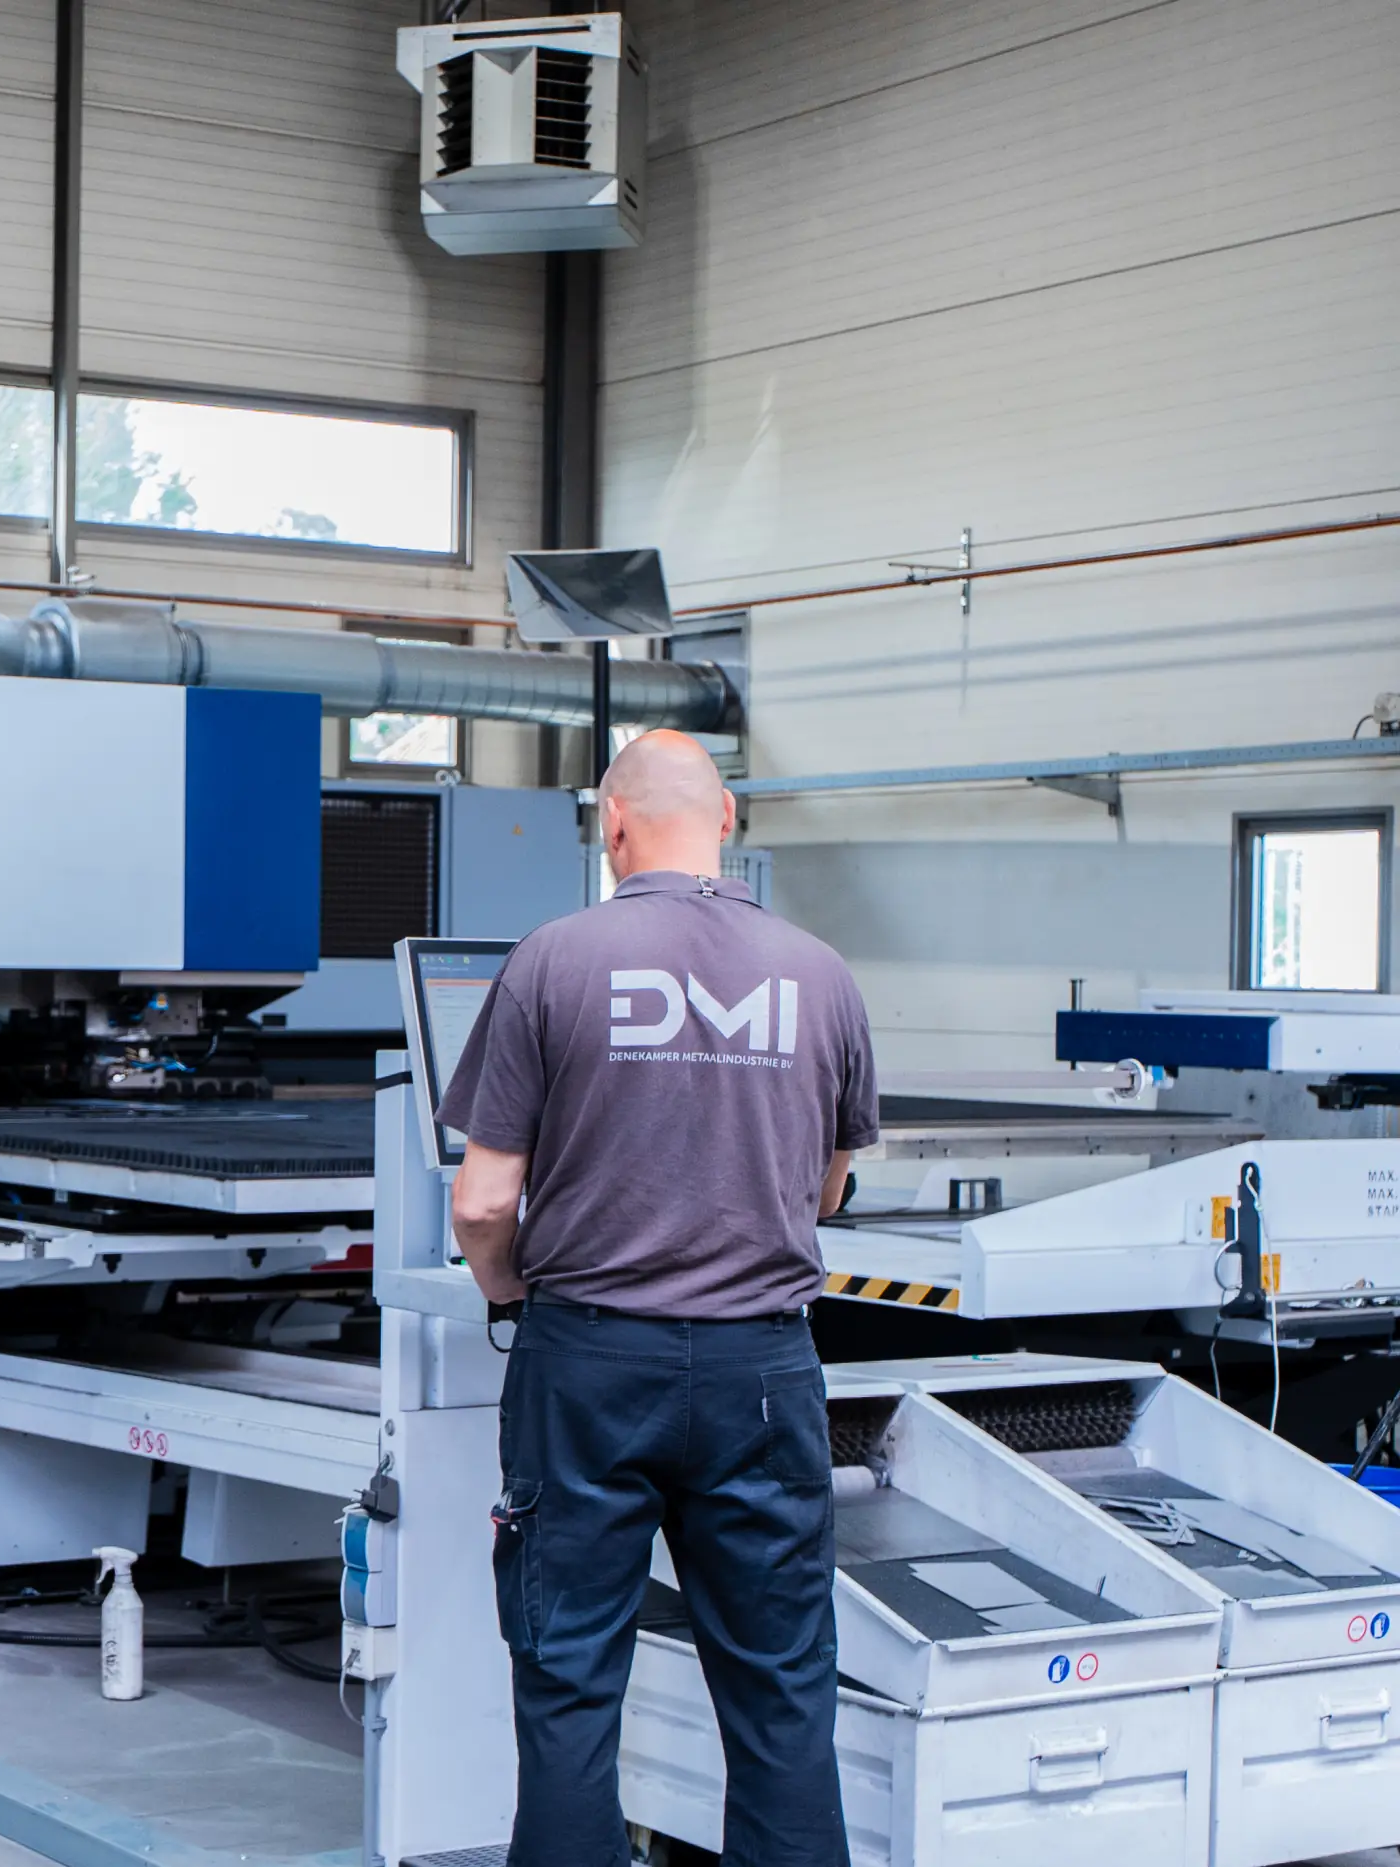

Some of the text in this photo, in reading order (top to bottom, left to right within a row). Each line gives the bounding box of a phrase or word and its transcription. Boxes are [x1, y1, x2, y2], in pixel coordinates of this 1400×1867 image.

[610, 969, 798, 1054] DMI
[609, 1051, 794, 1069] DENEKAMPER METAALINDUSTRIE BV
[1368, 1170, 1398, 1182] MAX.
[1368, 1188, 1398, 1200] MAX.
